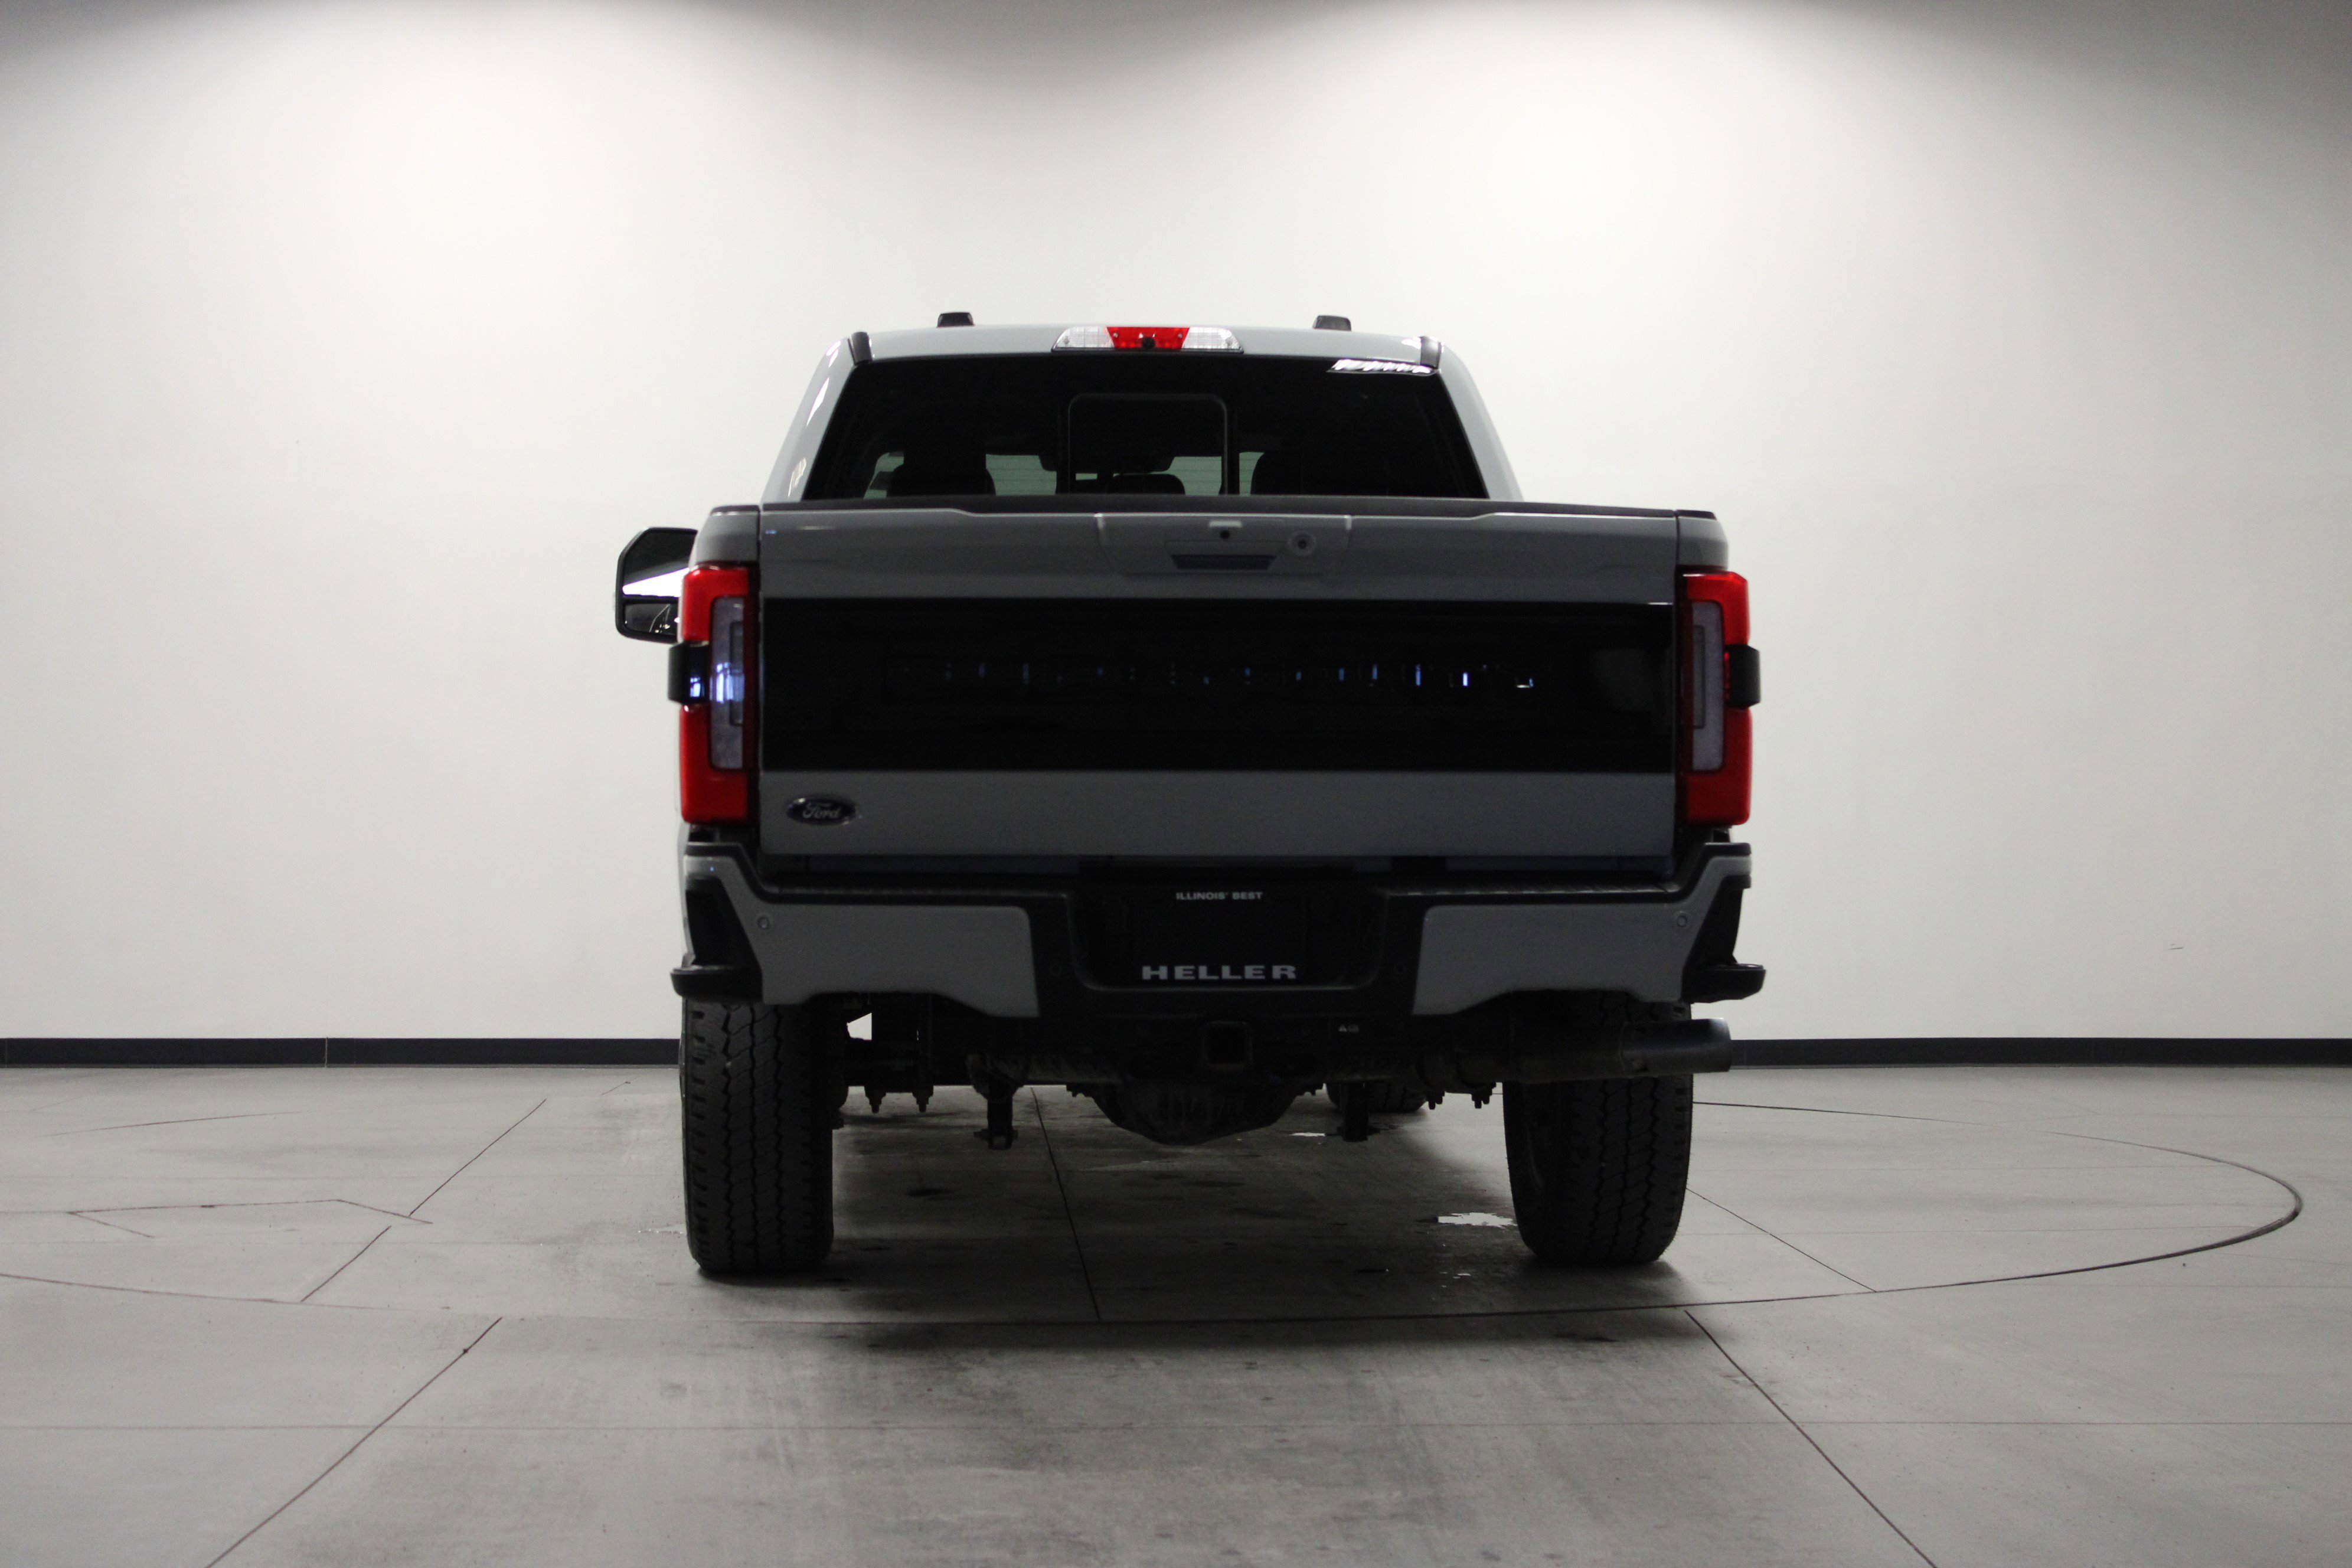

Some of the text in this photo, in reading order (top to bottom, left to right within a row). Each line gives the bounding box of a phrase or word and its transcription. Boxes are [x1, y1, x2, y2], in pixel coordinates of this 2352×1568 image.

[802, 802, 841, 819] Ford
[1232, 891, 1263, 900] BEST
[1142, 965, 1297, 980] HELLER
